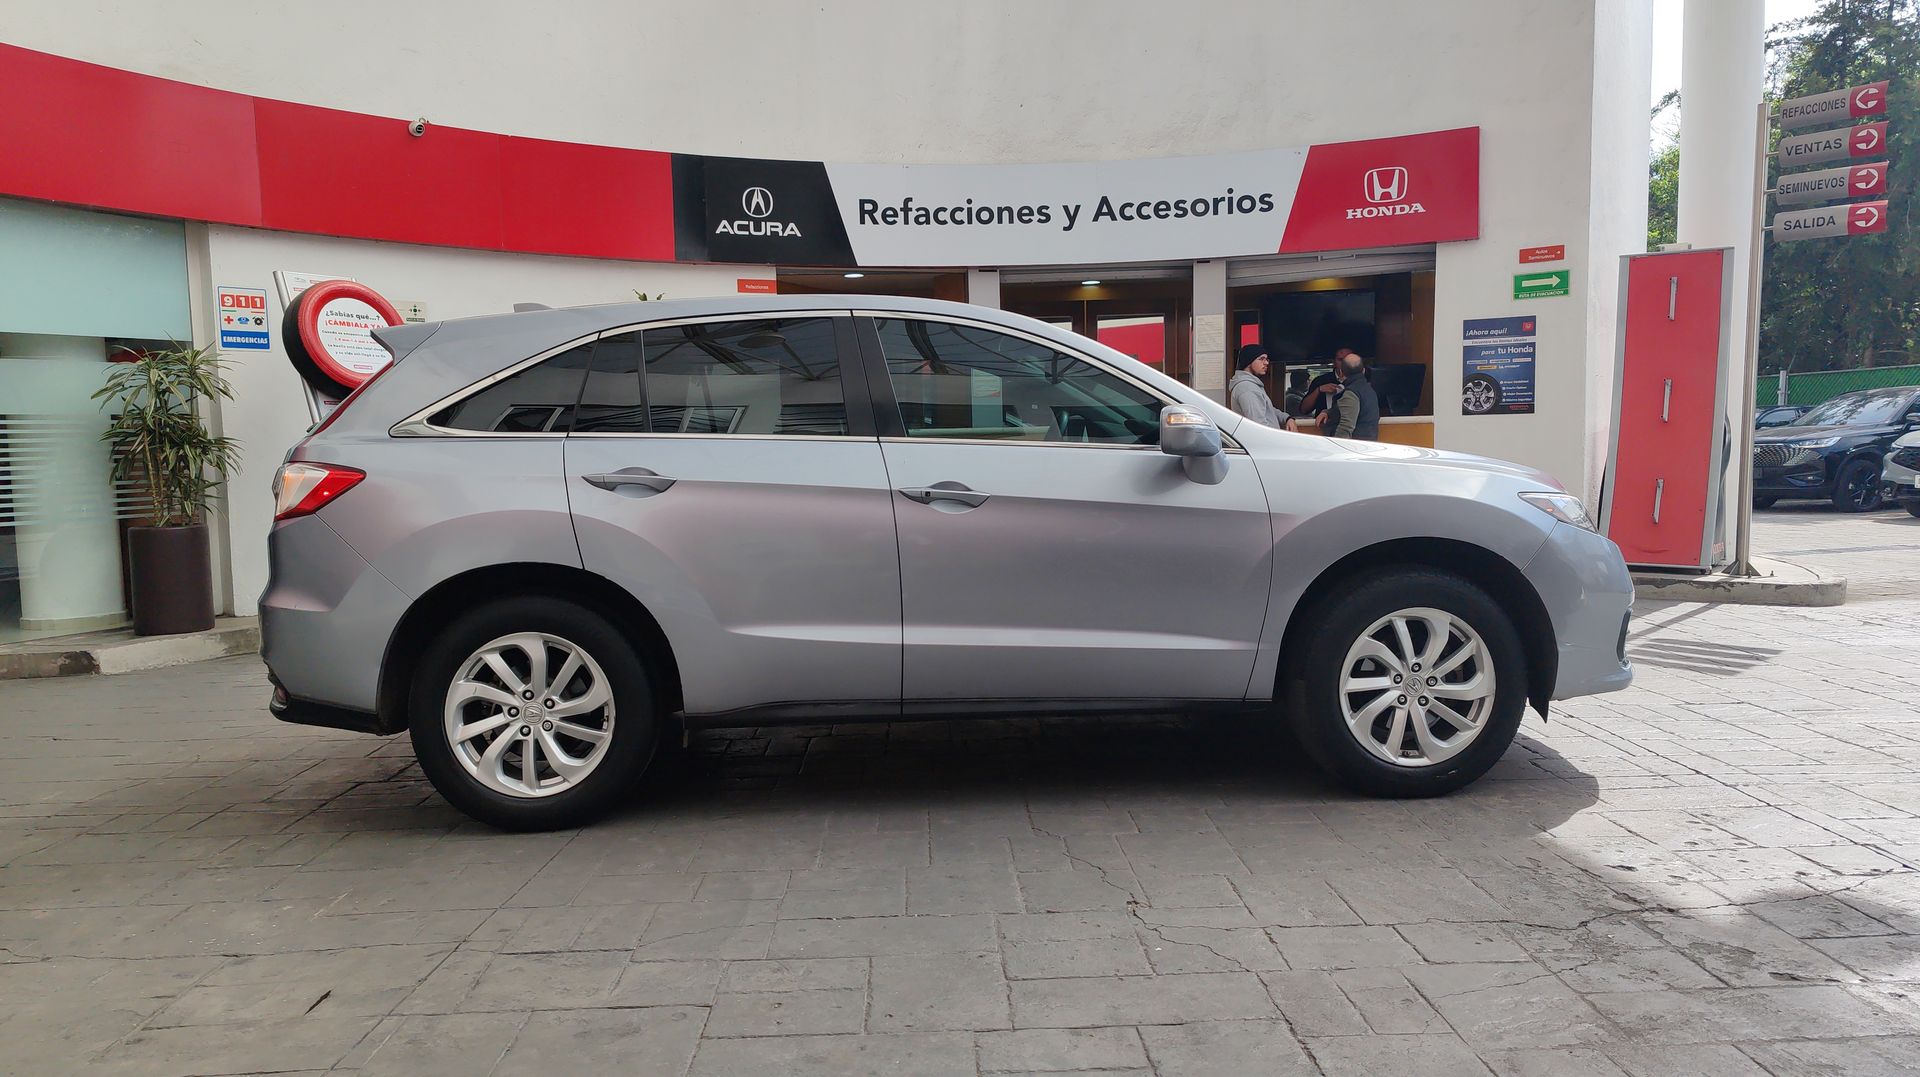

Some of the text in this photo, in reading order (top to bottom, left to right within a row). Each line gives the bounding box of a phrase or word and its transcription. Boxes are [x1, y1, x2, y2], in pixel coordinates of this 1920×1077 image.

[1782, 98, 1846, 119] REFACCIONES
[1785, 138, 1842, 156] VENTAS
[1779, 176, 1845, 194] SEMINUEVOS
[858, 188, 1274, 232] Refacciones y Accesorios
[1346, 202, 1426, 220] HONDA
[715, 220, 802, 237] ACURA
[1783, 215, 1836, 231] SALIDA
[222, 336, 268, 344] EMERGENCIAS
[1508, 346, 1534, 354] Honda
